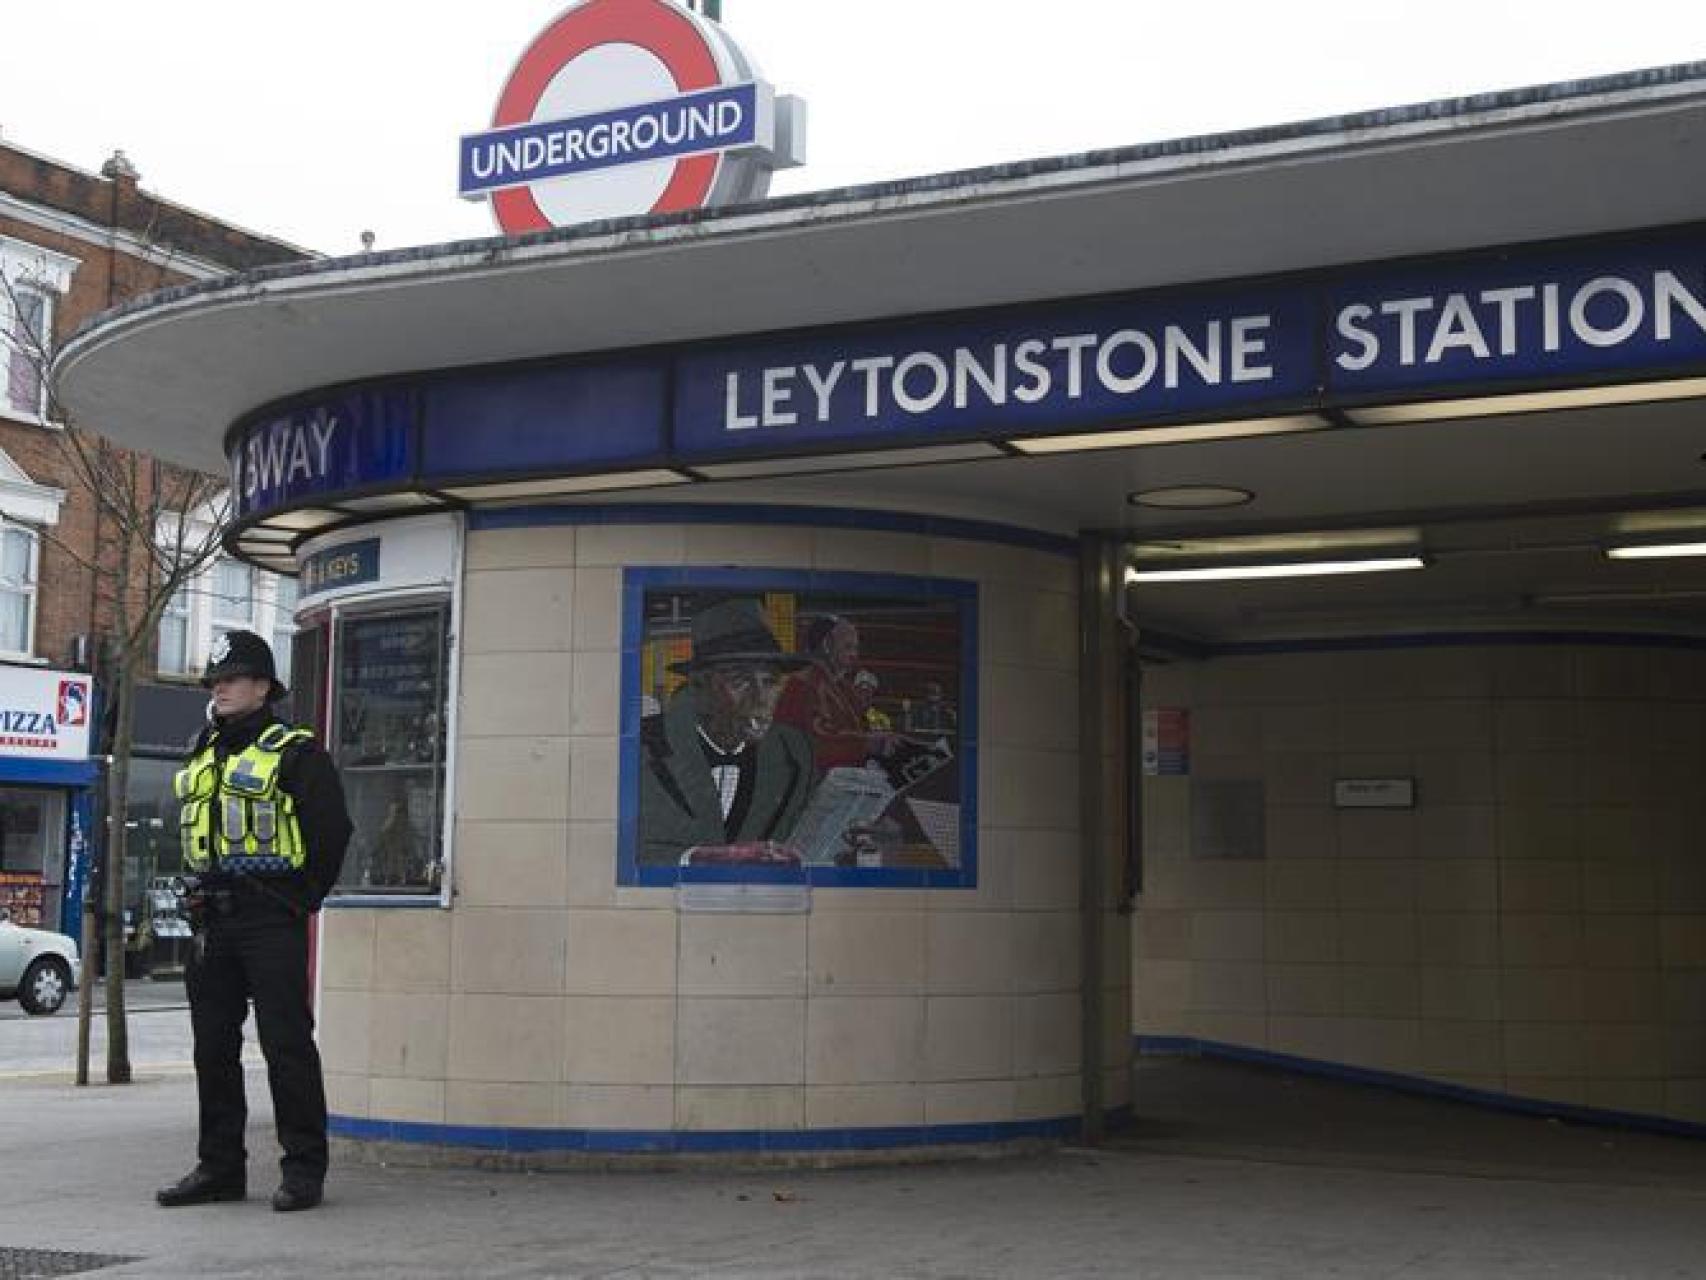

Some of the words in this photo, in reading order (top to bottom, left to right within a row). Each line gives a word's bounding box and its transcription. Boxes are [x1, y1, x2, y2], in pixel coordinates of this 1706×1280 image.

[471, 100, 743, 178] UNDERGROUND
[725, 315, 1274, 431] LEYTONSTONE
[1334, 270, 1706, 371] STATION
[234, 417, 338, 505] BWAY
[0, 710, 57, 735] IZZA
